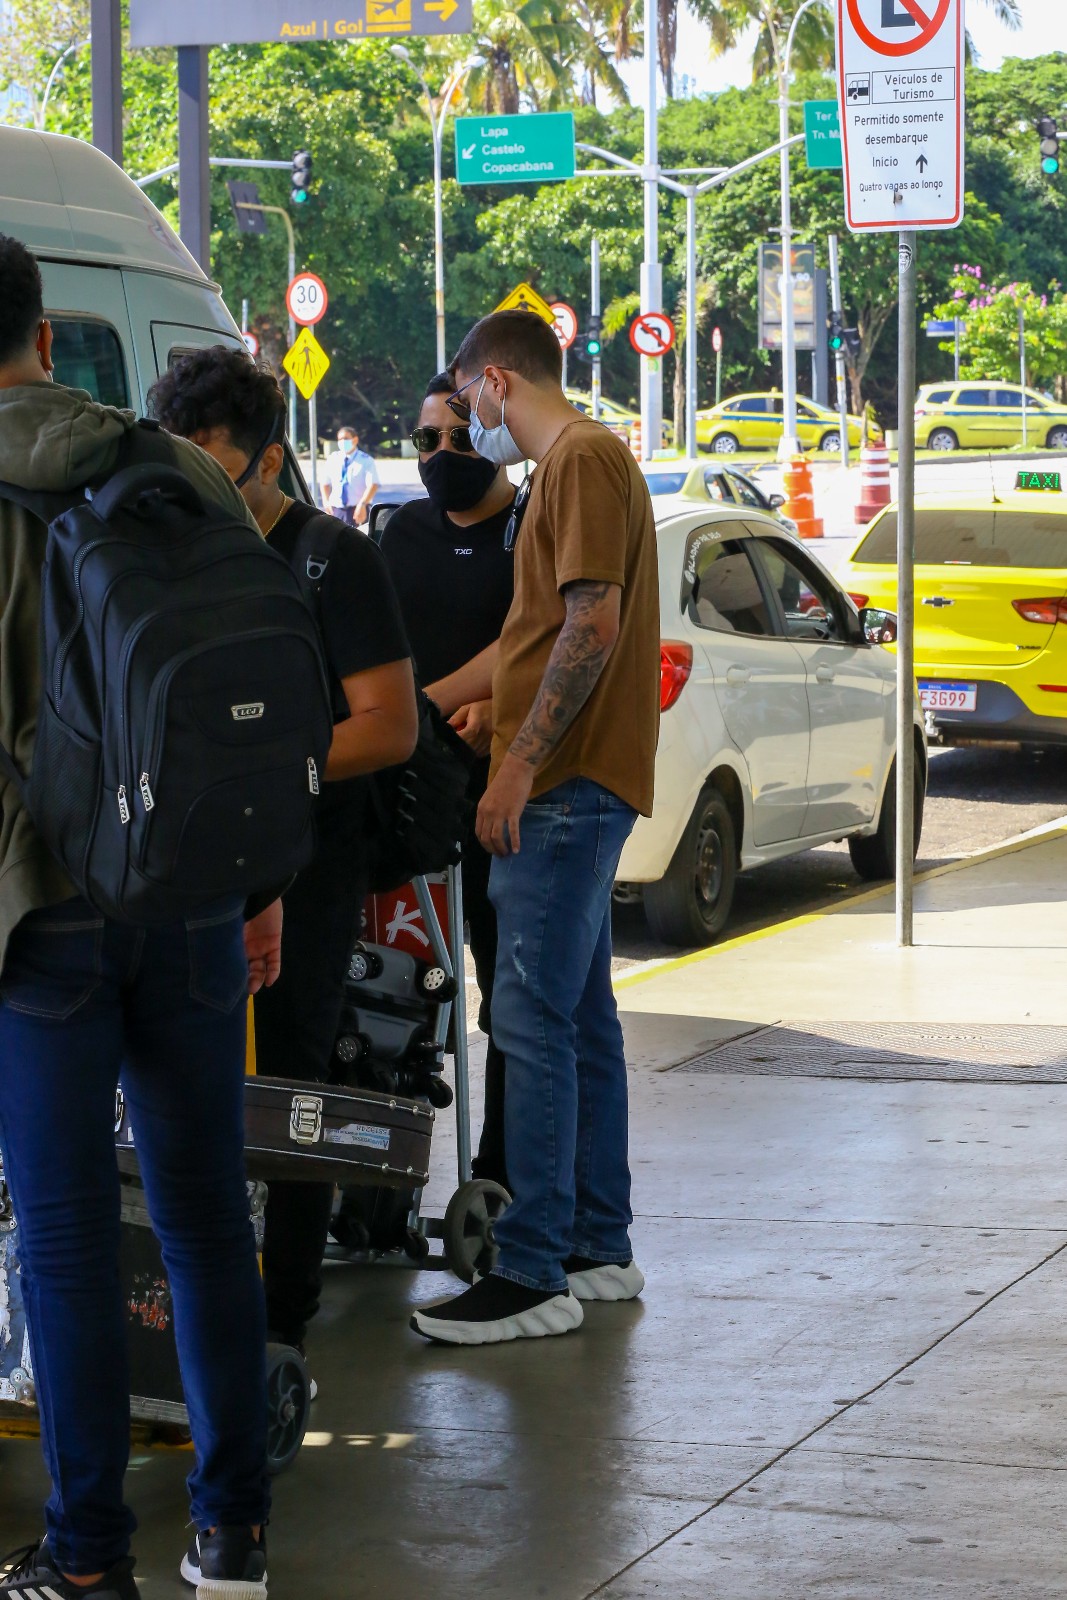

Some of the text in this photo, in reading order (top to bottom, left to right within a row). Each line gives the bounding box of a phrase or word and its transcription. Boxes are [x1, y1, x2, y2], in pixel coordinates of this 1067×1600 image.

[280, 19, 364, 37] Azul Gol
[931, 72, 943, 83] de
[893, 88, 935, 100] Turismo
[854, 113, 900, 126] Permitido
[902, 112, 944, 124] somente
[480, 126, 509, 139] Lapa
[865, 133, 929, 146] desembarque
[482, 143, 526, 156] Castelo
[482, 161, 555, 175] Copacabana
[860, 180, 944, 193] Quatro vagas ao longo
[297, 285, 318, 304] 30
[1018, 472, 1060, 488] TAXI
[920, 691, 967, 707] F3G99
